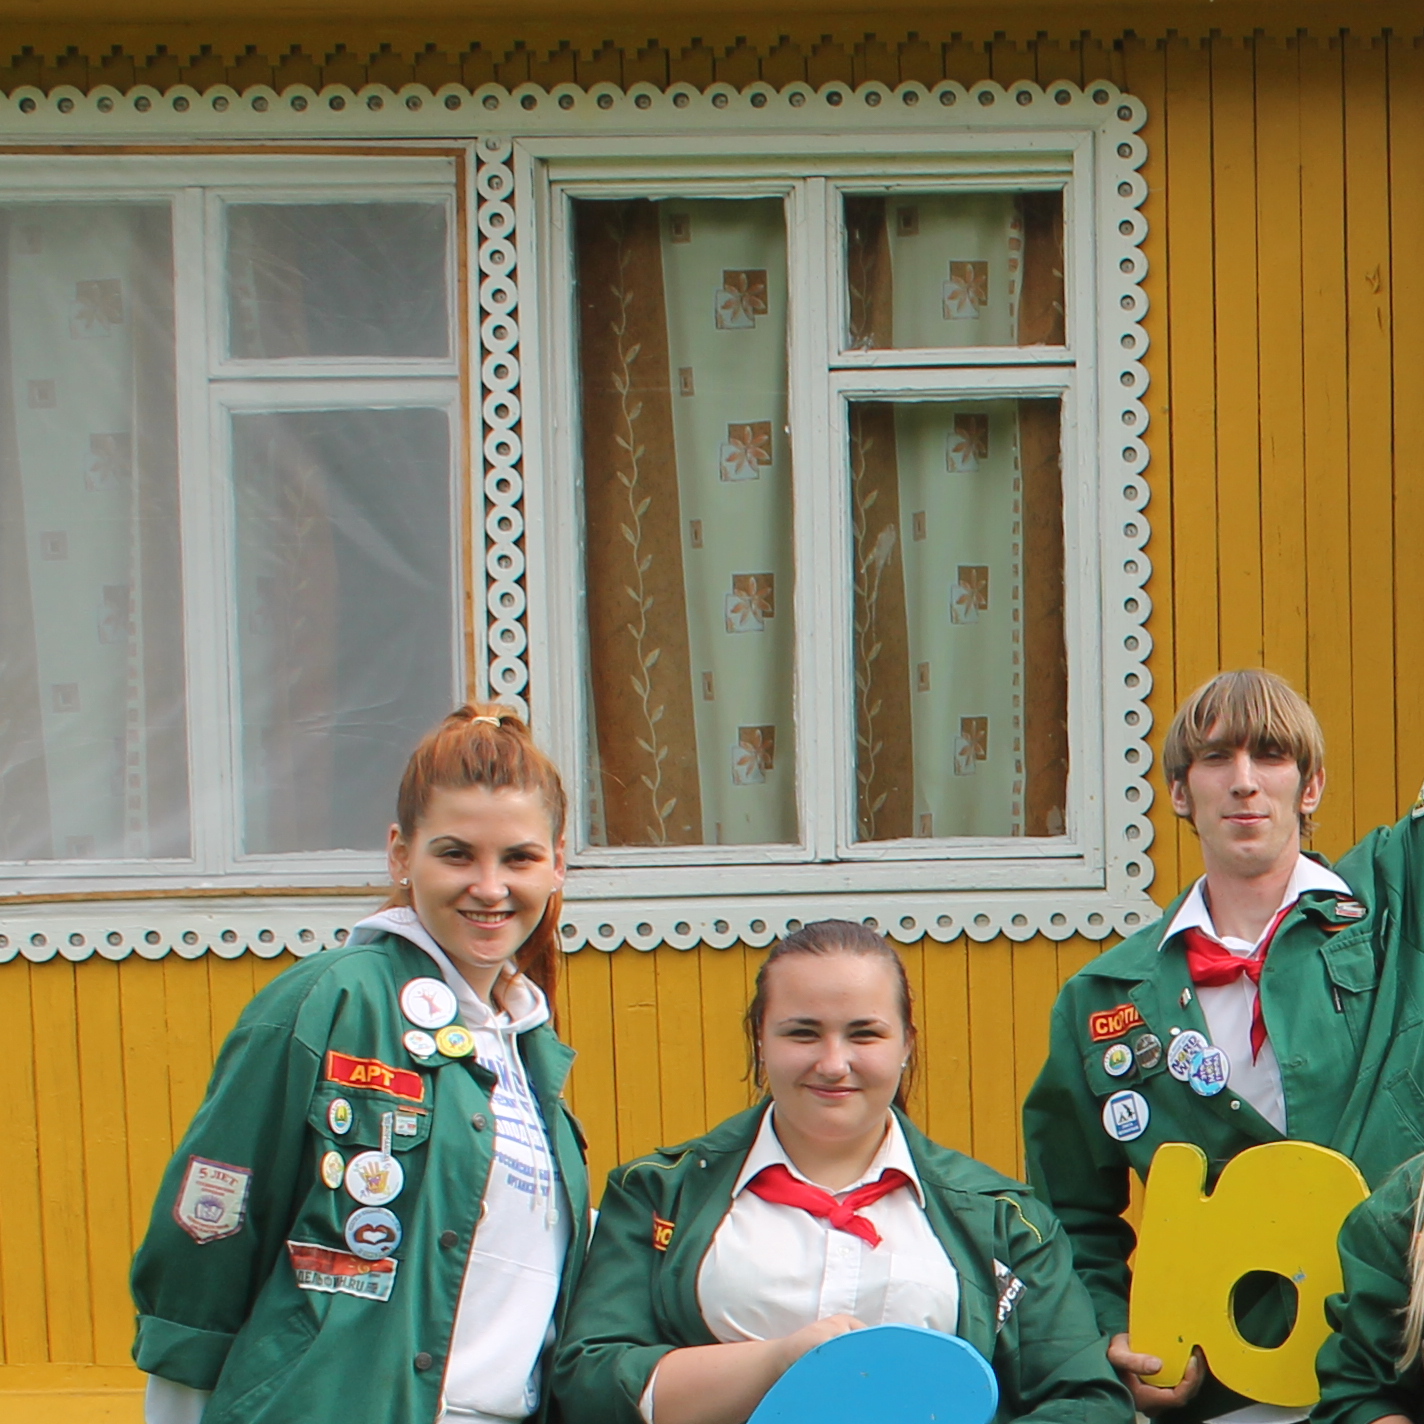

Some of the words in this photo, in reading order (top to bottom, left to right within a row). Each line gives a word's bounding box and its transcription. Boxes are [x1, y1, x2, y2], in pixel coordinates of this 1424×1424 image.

[350, 1065, 395, 1086] АРТ
[199, 1167, 209, 1179] 5
[211, 1170, 238, 1187] ЛЕТ
